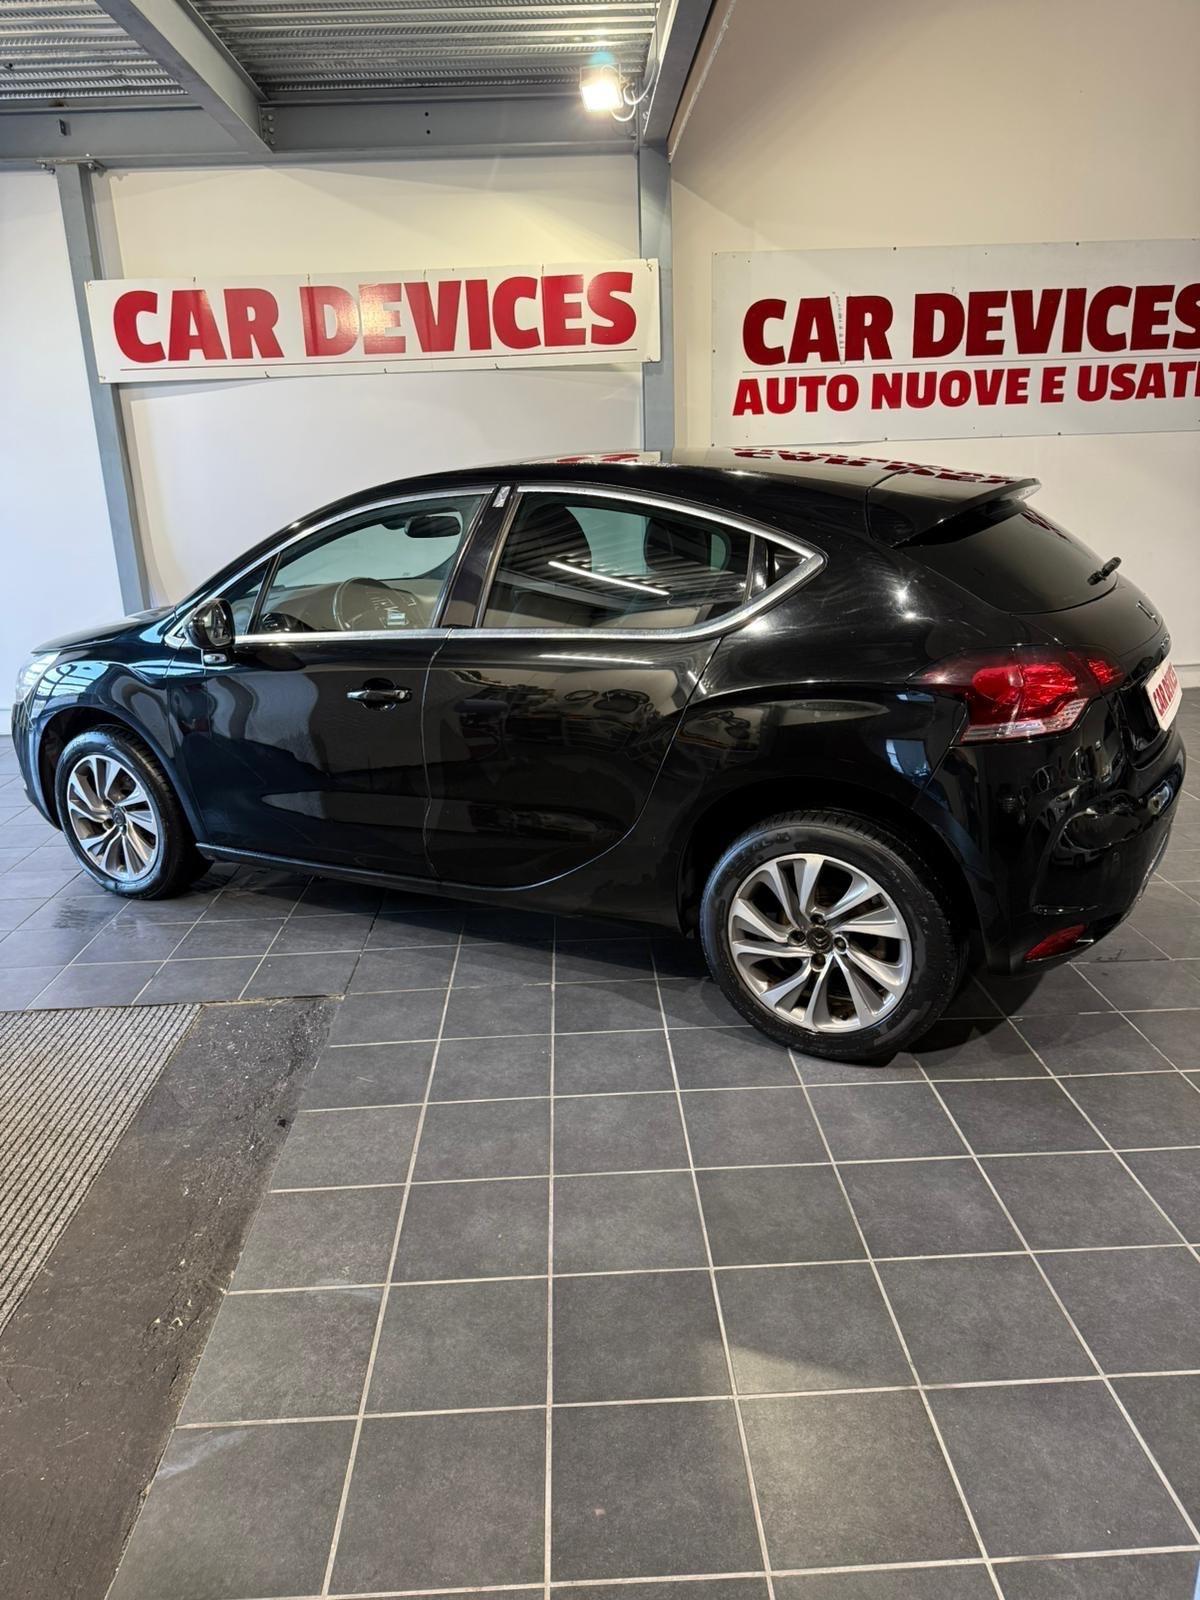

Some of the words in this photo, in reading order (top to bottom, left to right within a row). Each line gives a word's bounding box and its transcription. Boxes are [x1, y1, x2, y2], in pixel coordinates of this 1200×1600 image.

[112, 287, 285, 364] CAR
[299, 271, 638, 358] DEVICES
[742, 295, 894, 367] CAR
[912, 283, 1200, 360] DEVICES
[731, 373, 860, 417] AUTO
[870, 368, 1031, 411] NUOVE
[1040, 366, 1067, 404] E
